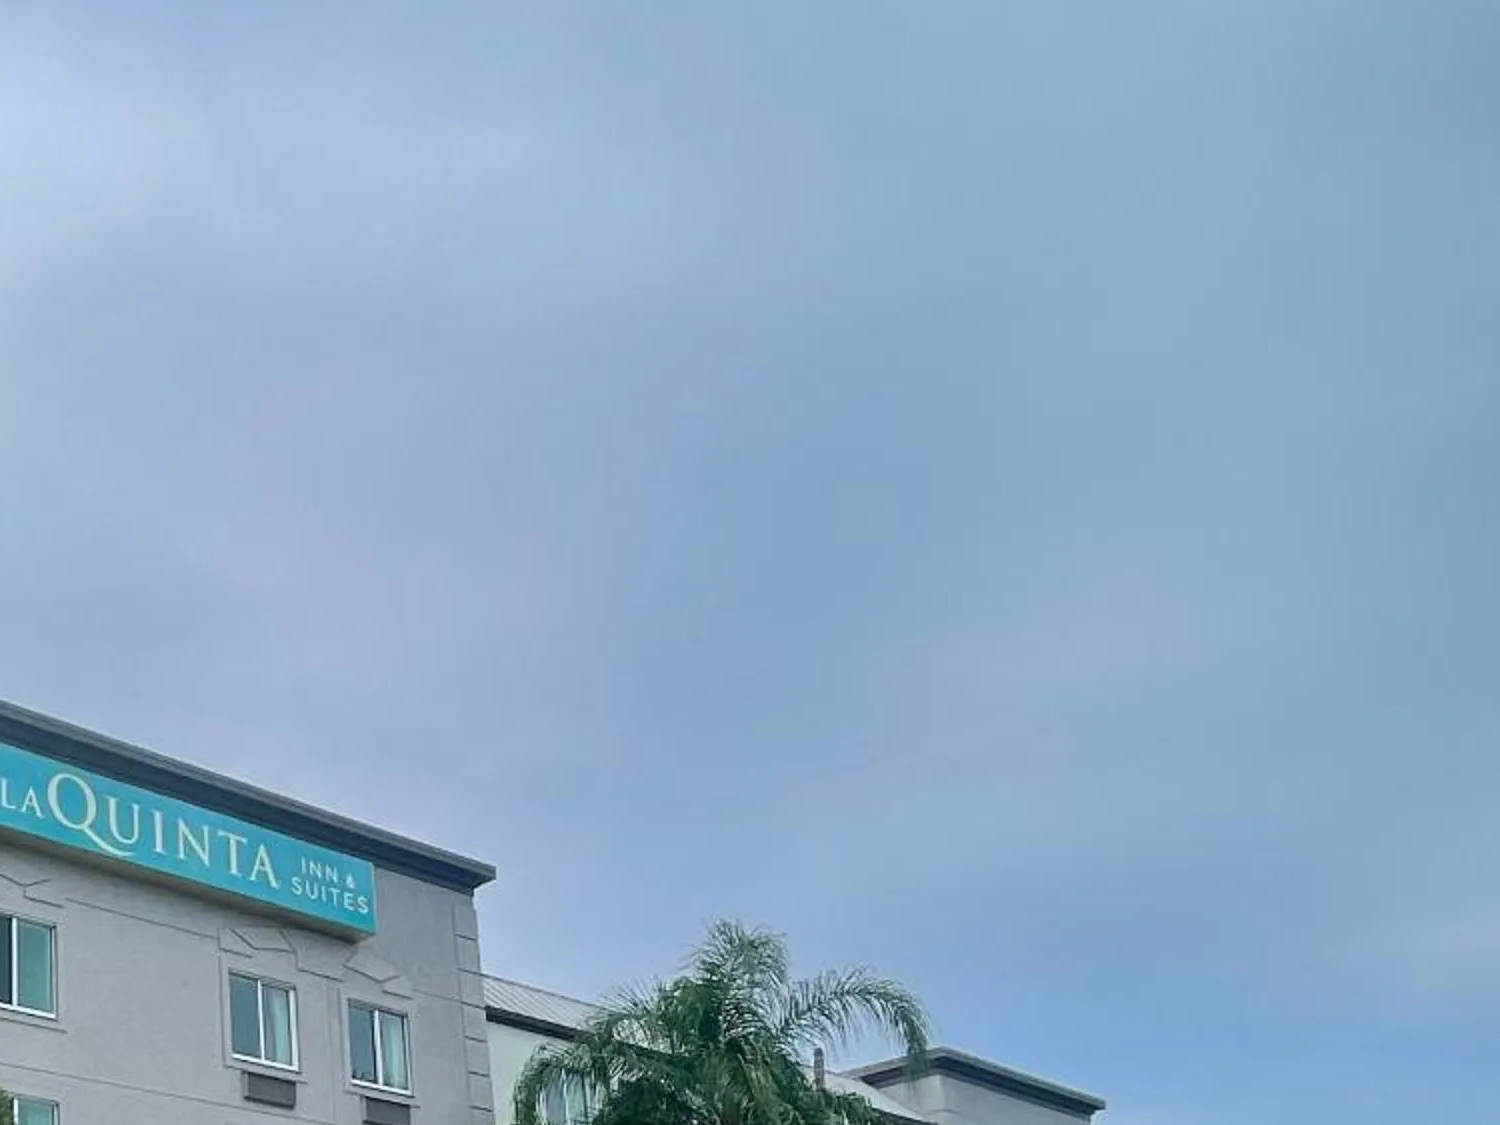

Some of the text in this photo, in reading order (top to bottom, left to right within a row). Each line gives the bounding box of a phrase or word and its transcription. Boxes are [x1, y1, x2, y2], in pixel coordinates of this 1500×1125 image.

[0, 772, 282, 890] LA QUINTA
[301, 855, 339, 885] INN
[291, 876, 370, 915] SUITES
